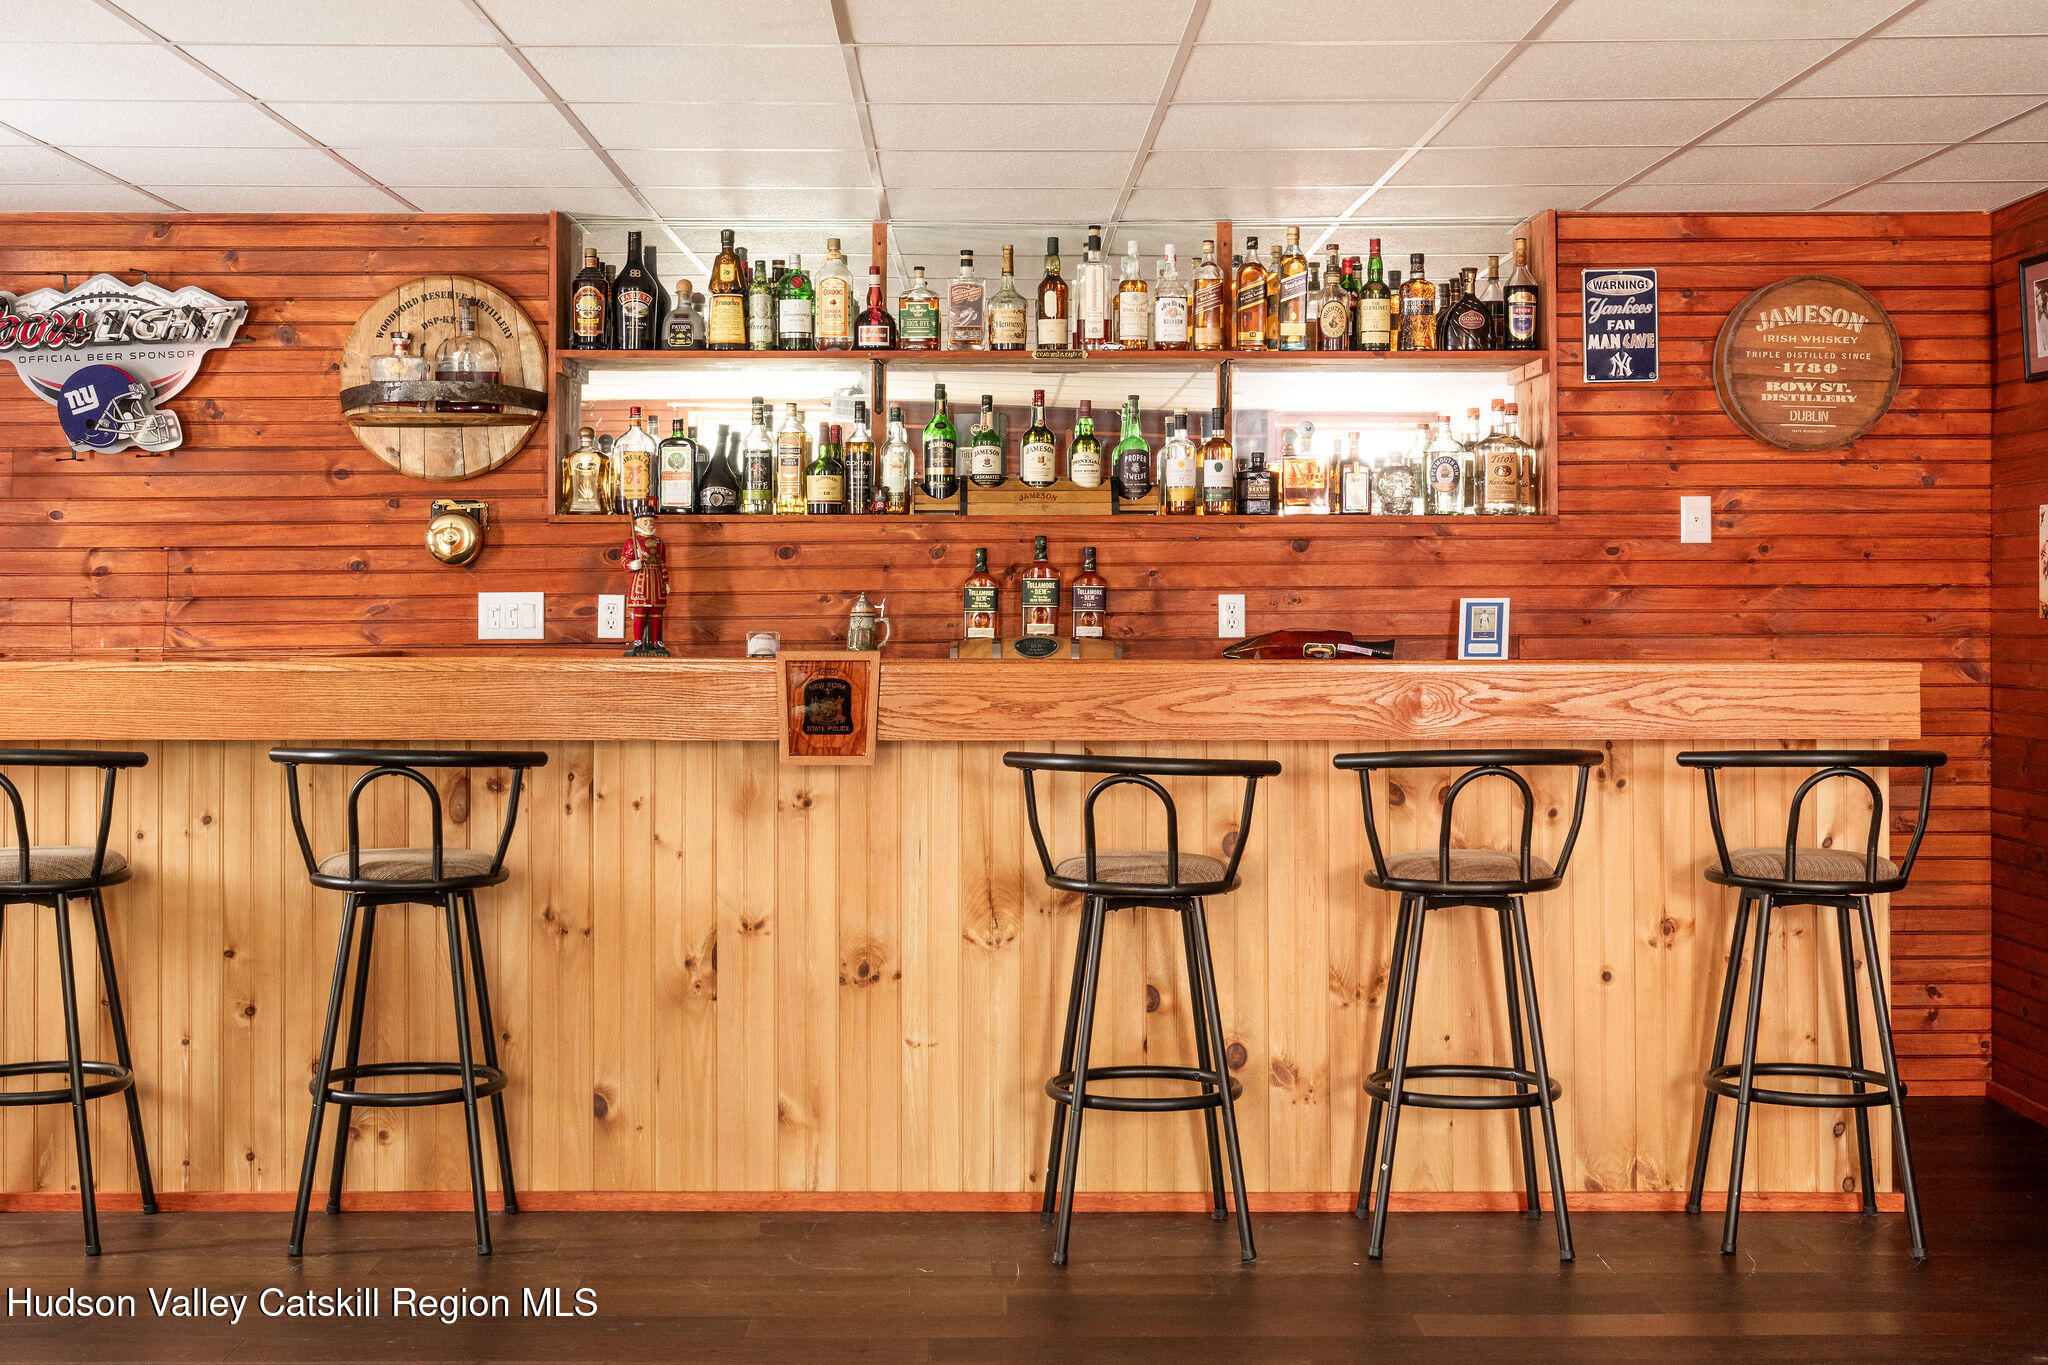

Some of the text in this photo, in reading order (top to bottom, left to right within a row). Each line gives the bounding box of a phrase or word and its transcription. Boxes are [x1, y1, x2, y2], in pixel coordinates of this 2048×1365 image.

[1592, 280, 1648, 290] WARNING!
[375, 297, 419, 339] WOODFORD
[420, 290, 468, 303] RESERVE
[1587, 296, 1654, 324] Yankees
[1755, 305, 1866, 334] JAMESON
[93, 306, 238, 344] LIGHT
[1606, 319, 1635, 331] FAN
[1587, 332, 1655, 349] MAN CAVE
[1763, 334, 1858, 344] IRISH WHISKEY
[18, 350, 195, 364] OFFICIAL BEER SPONSOR
[1746, 350, 1871, 360] TRIPLE DISTILLED SINCE
[1765, 381, 1852, 393] BOW ST.
[1760, 393, 1857, 403] DISTILLERY
[1789, 410, 1829, 422] DUBLIN
[927, 441, 954, 450] JAMESON
[1025, 445, 1054, 455] JAMESON
[973, 449, 1000, 457] JAMESON
[1124, 453, 1147, 463] PROPER
[1491, 455, 1515, 463] Tito's
[1430, 457, 1455, 475] PLYMOUTH
[1124, 471, 1147, 481] TWELVE
[1019, 492, 1058, 502] JAMESON
[1025, 581, 1056, 589] TULLAMORE
[968, 589, 995, 597] TULLAMORE
[809, 682, 847, 691] NEW YORK
